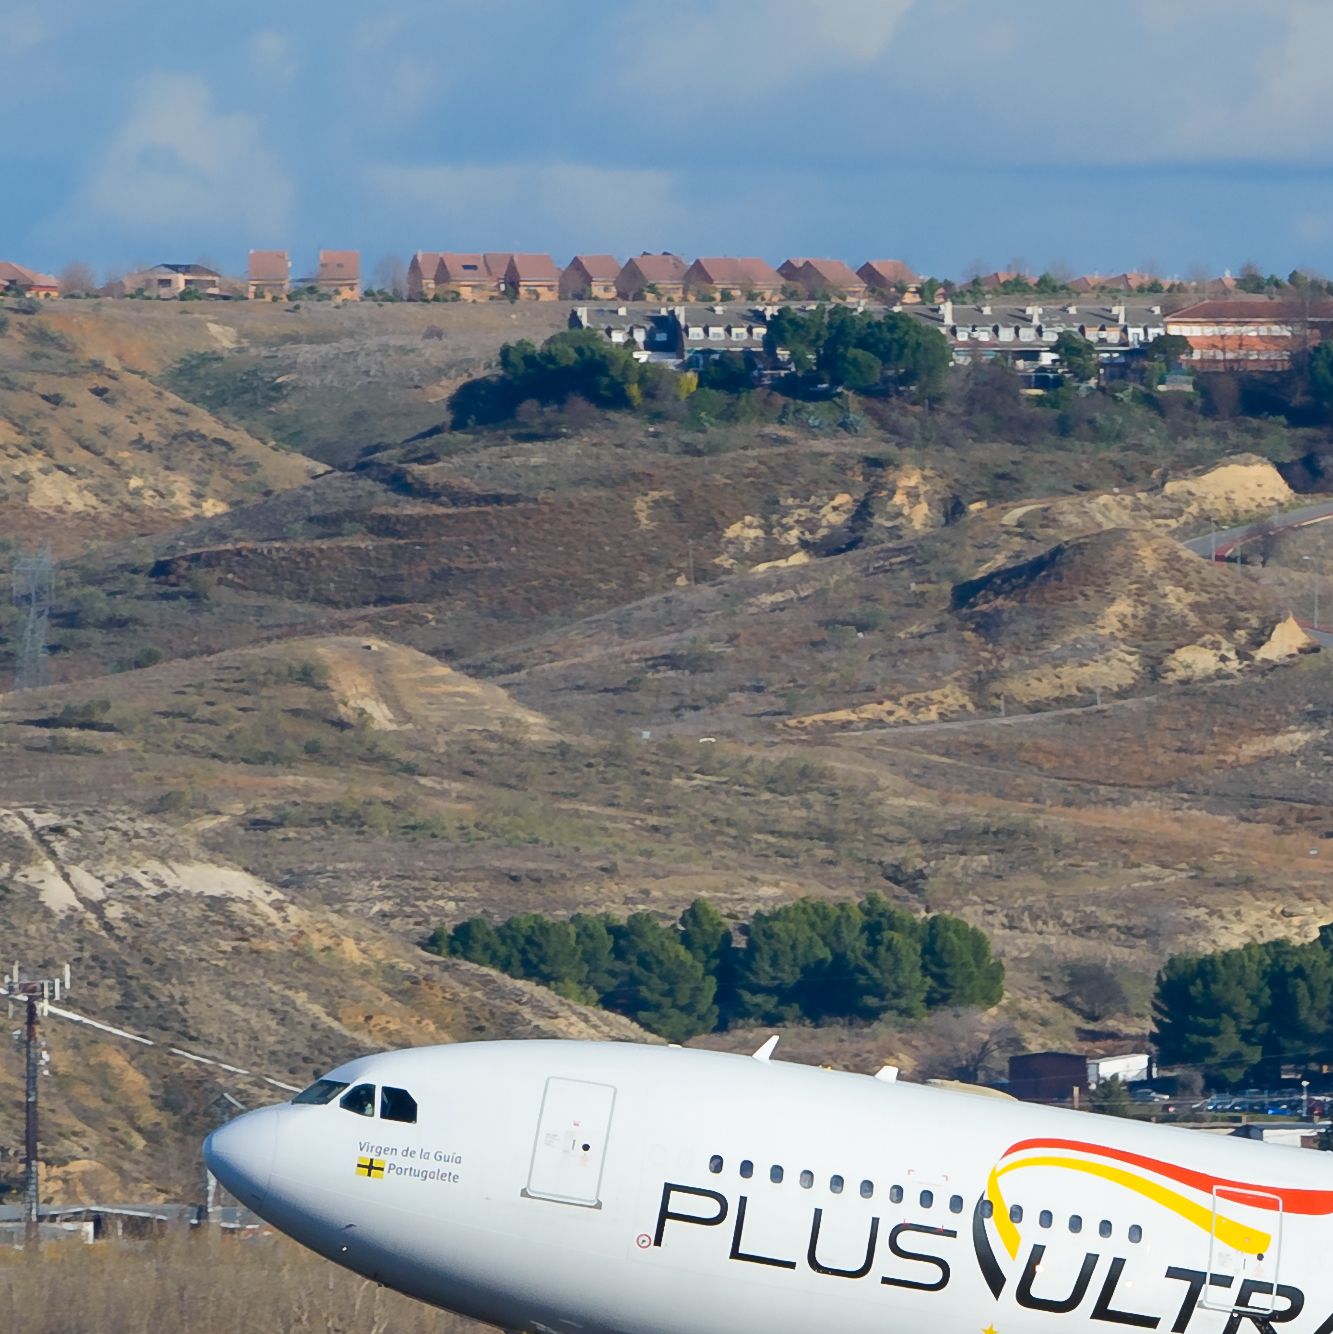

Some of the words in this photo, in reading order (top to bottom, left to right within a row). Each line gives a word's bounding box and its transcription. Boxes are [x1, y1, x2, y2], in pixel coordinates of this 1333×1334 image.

[359, 1141, 398, 1157] Virgen
[401, 1147, 416, 1158] de
[419, 1148, 430, 1160] la
[434, 1151, 462, 1164] Guía
[387, 1163, 459, 1183] Portugalete
[653, 1182, 957, 1292] PLUS
